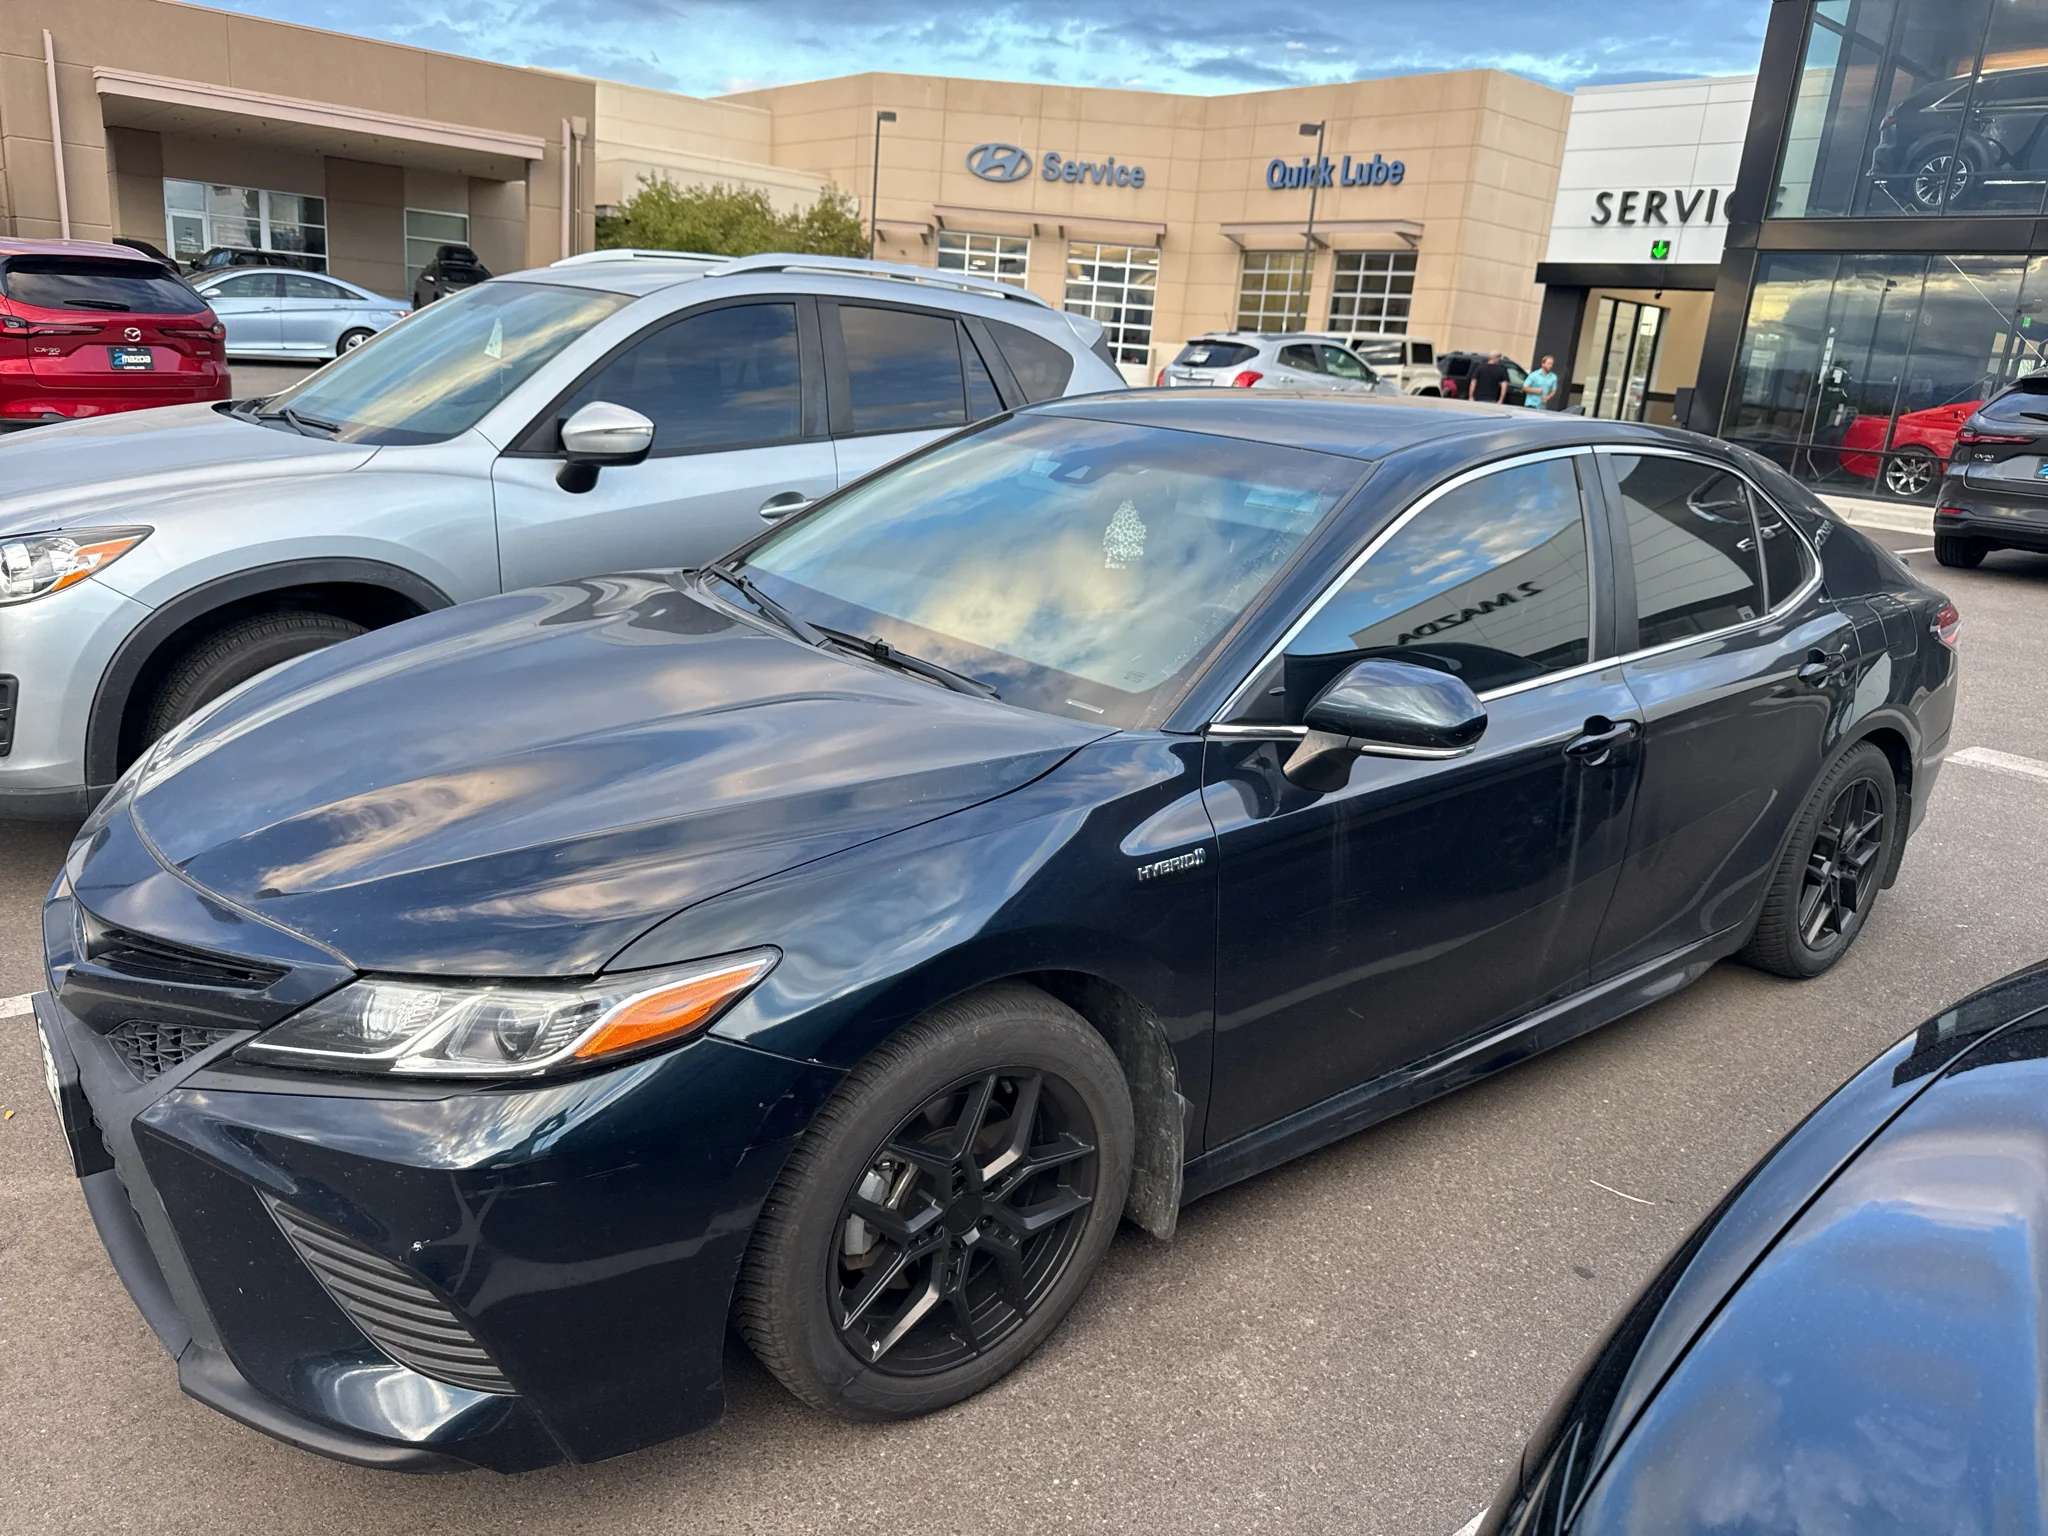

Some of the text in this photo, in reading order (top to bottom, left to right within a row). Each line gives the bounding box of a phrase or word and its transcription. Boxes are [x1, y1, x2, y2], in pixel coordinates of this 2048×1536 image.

[1042, 152, 1146, 189] Service
[1266, 153, 1406, 190] Quick Lube
[1137, 853, 1196, 881] HYBRID
